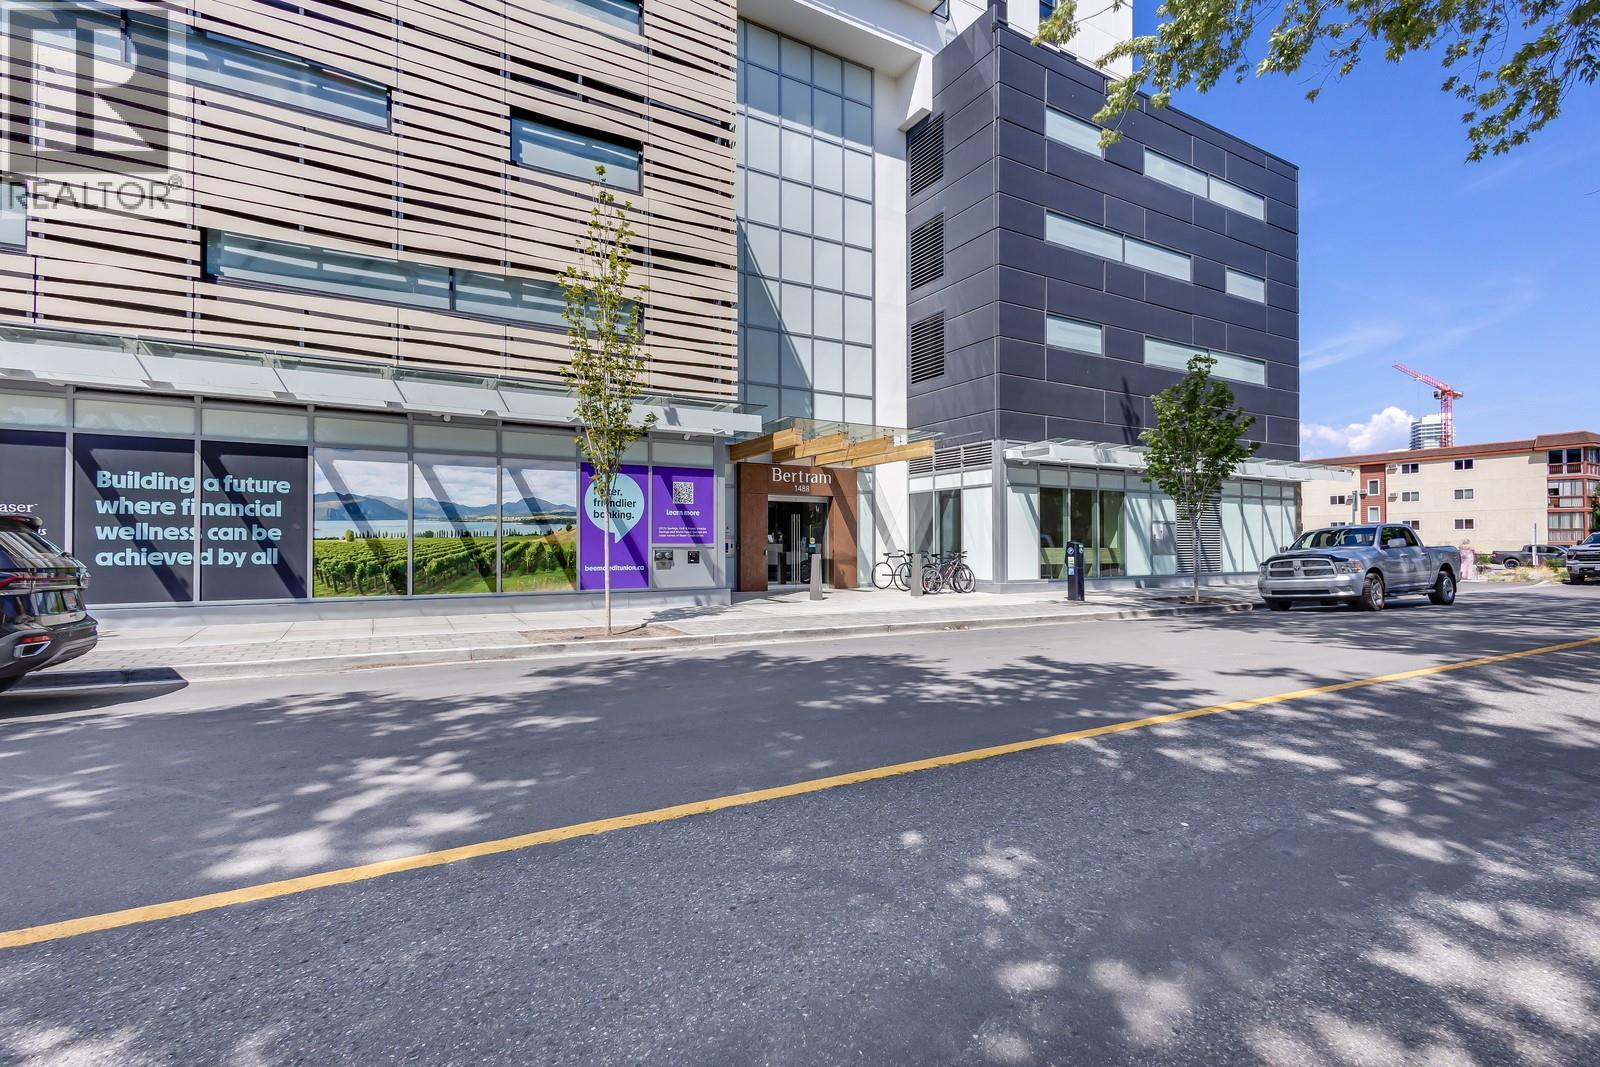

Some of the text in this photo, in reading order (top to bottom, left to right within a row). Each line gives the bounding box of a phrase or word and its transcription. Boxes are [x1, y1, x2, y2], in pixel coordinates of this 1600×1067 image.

[96, 470, 291, 494] Building a future
[771, 467, 832, 484] Bertram
[794, 485, 810, 493] 1488
[95, 496, 282, 517] where financial
[593, 498, 637, 508] frindlier
[207, 527, 248, 541] can
[252, 524, 282, 541] be
[95, 547, 279, 568] achieved by all
